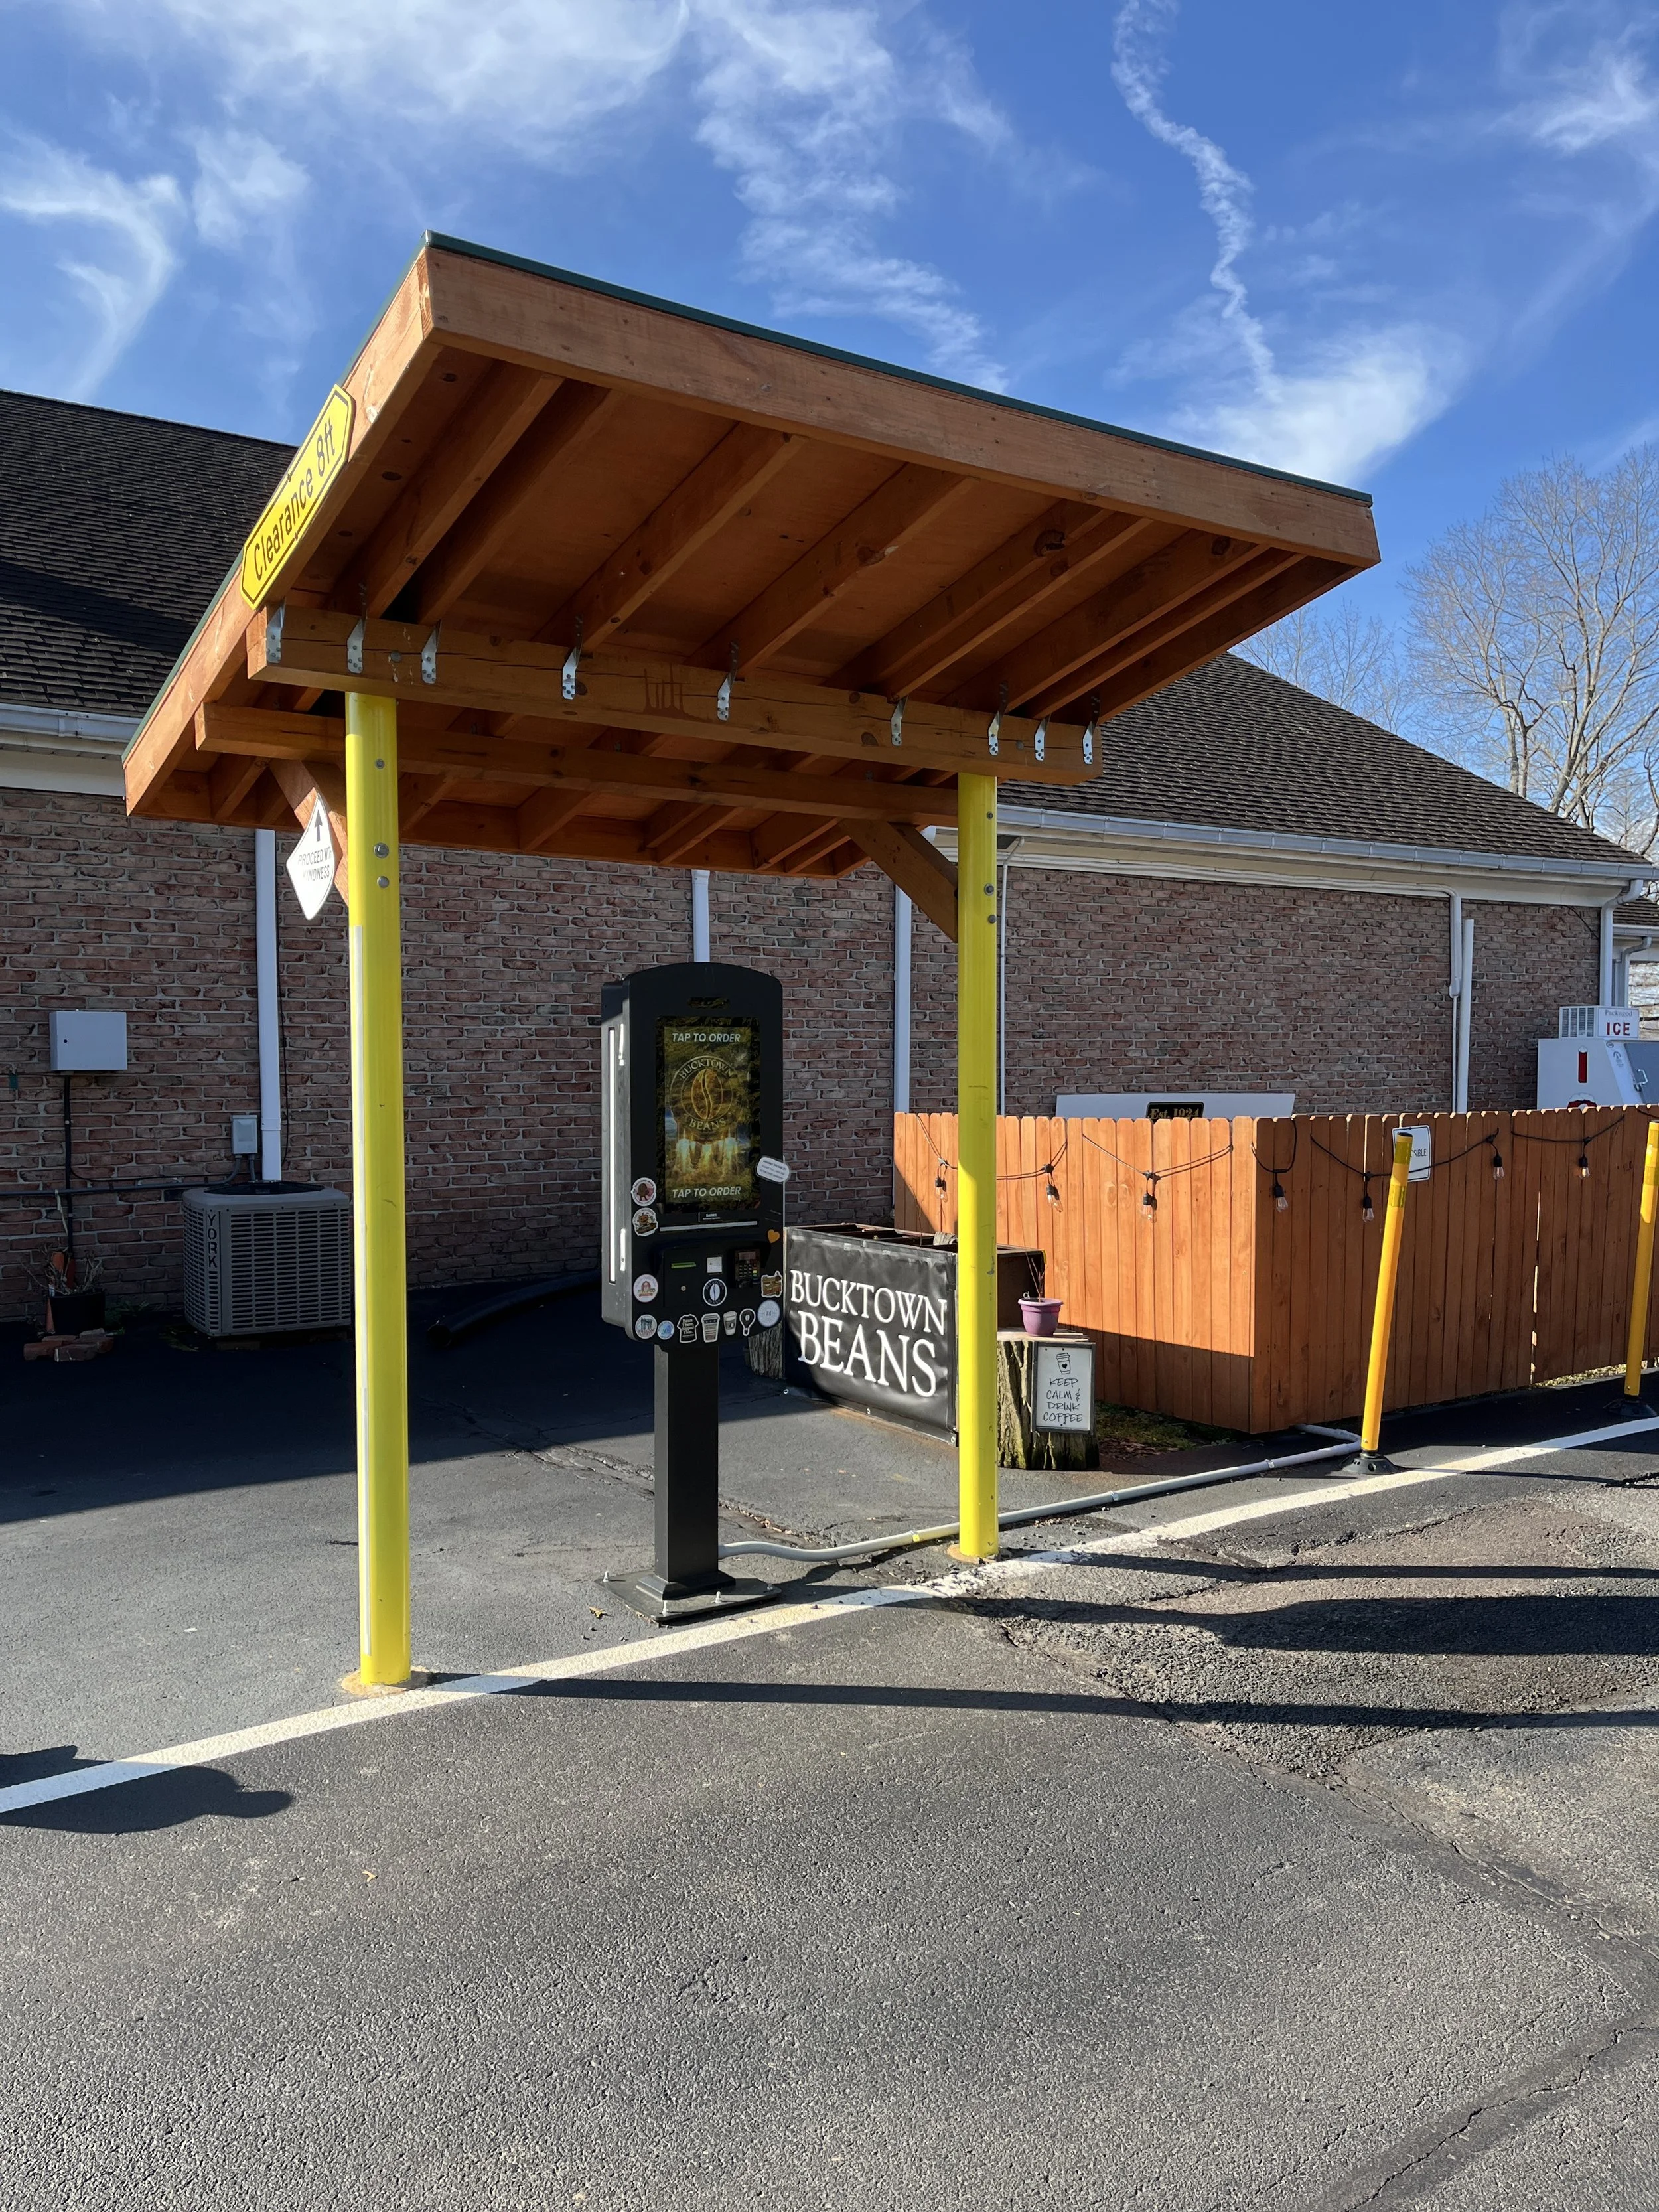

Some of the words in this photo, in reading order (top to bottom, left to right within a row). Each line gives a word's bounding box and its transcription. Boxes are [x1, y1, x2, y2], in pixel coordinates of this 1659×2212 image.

[254, 467, 313, 581] Clearance
[298, 849, 323, 865] PROCEED
[1607, 1022, 1630, 1036] ICE
[672, 1033, 691, 1042] TAP
[693, 1033, 707, 1042] TO
[709, 1033, 741, 1043] ORDER
[1149, 1108, 1170, 1120] Est.
[689, 1118, 726, 1130] BEANS
[1410, 1149, 1427, 1157] SIBLE
[672, 1189, 691, 1199] TAP
[693, 1188, 707, 1197] TO
[709, 1186, 741, 1196] ORDER
[208, 1214, 218, 1268] YORK
[790, 1269, 947, 1336] BUCKTOWN
[798, 1310, 936, 1397] BEANS
[1049, 1378, 1078, 1388] KEEP
[1046, 1390, 1072, 1400] CALM
[1046, 1402, 1081, 1411] DRINK
[1043, 1412, 1083, 1425] COFFEE
